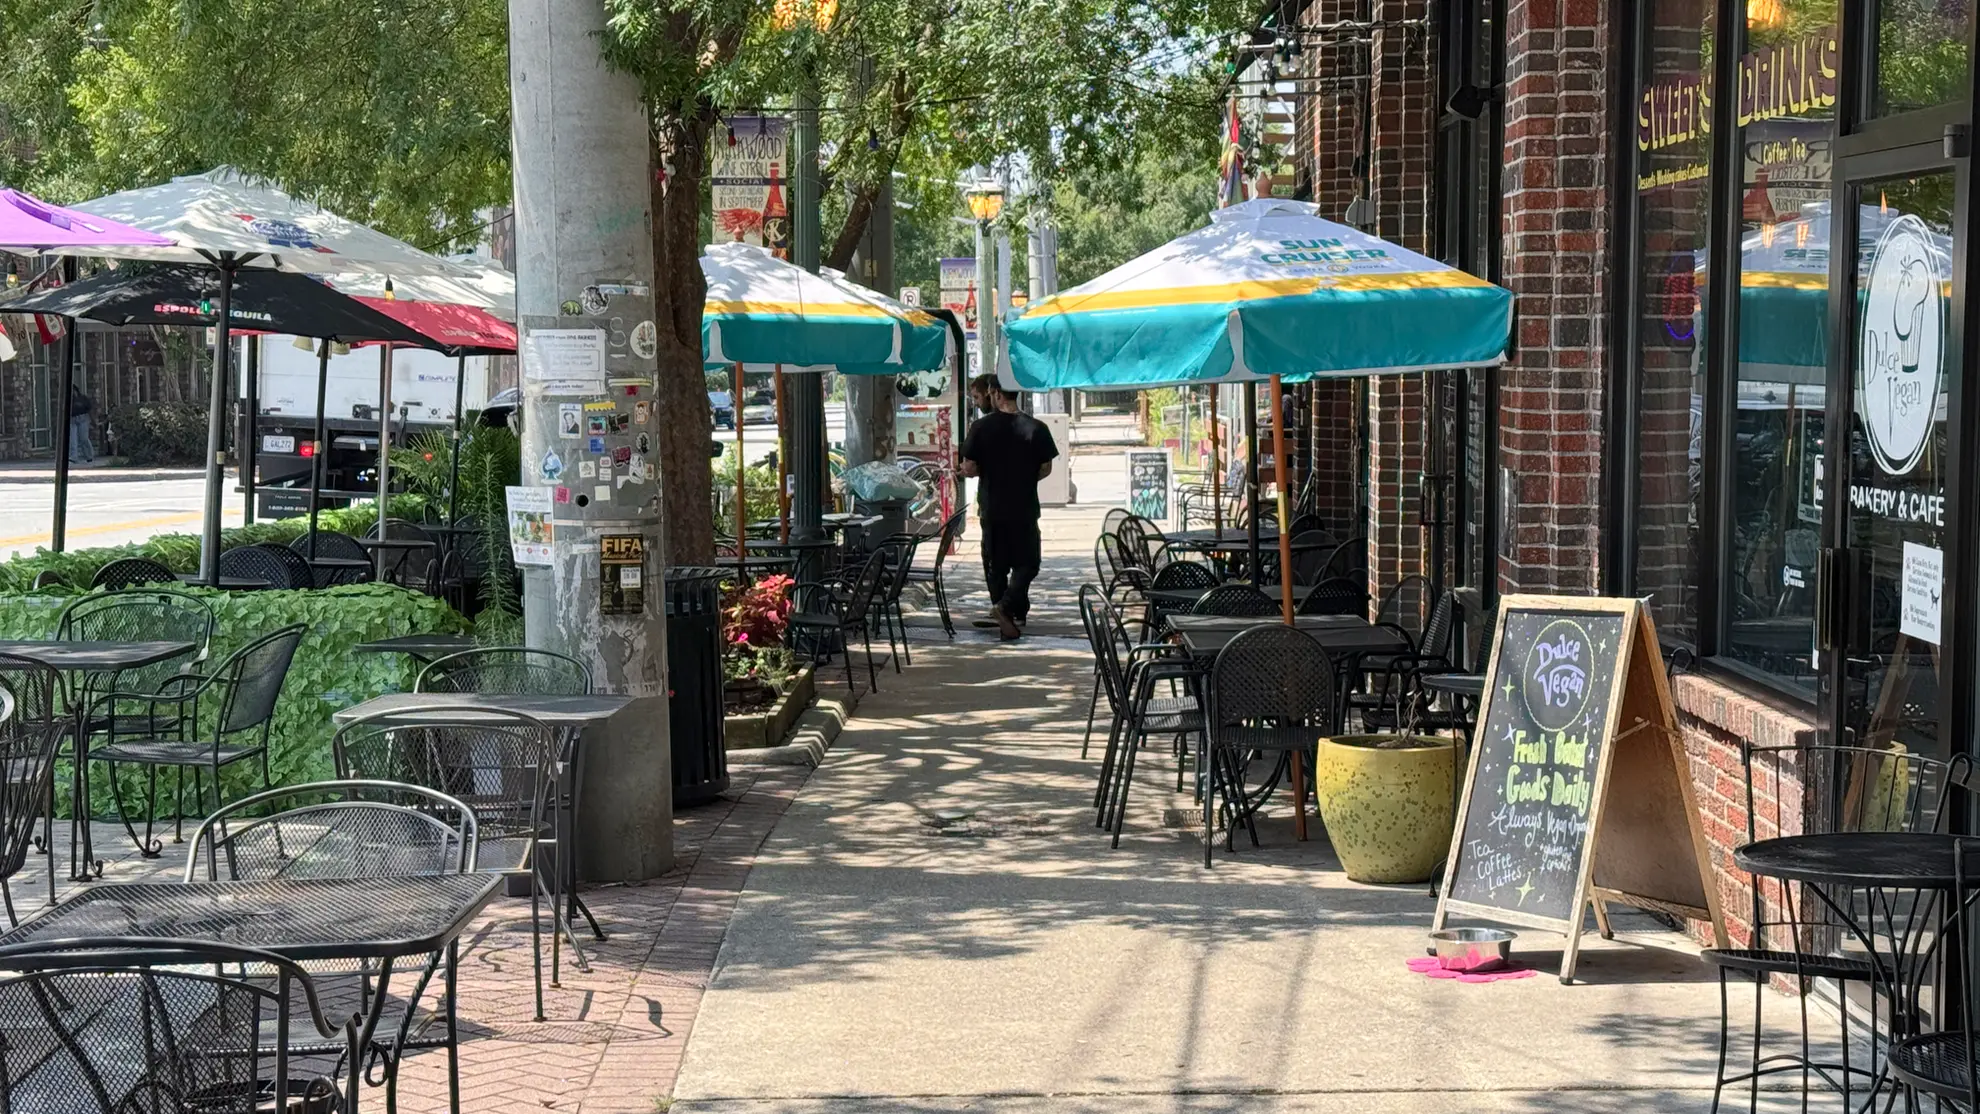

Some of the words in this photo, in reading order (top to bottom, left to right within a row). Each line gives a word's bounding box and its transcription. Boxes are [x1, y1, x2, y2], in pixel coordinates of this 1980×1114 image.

[1737, 33, 1836, 128] DRINKS
[1638, 74, 1711, 151] SWEETS
[1791, 137, 1806, 162] Tea
[1260, 248, 1392, 265] CRUISER
[1278, 238, 1344, 251] SUN
[1867, 329, 1900, 385] Dulce
[1887, 376, 1922, 447] Vegan
[1897, 489, 1907, 519] &
[1909, 487, 1945, 527] CAFÉ
[601, 538, 643, 553] FIFA
[1535, 634, 1581, 670] Dulce
[1536, 666, 1585, 707] Vegan
[1513, 730, 1548, 764] Fresh
[1506, 764, 1550, 805] Goods
[1551, 770, 1590, 817] Daily
[1488, 803, 1543, 849] Always
[1467, 839, 1495, 860] Tea
[1489, 864, 1523, 891] Lattes
